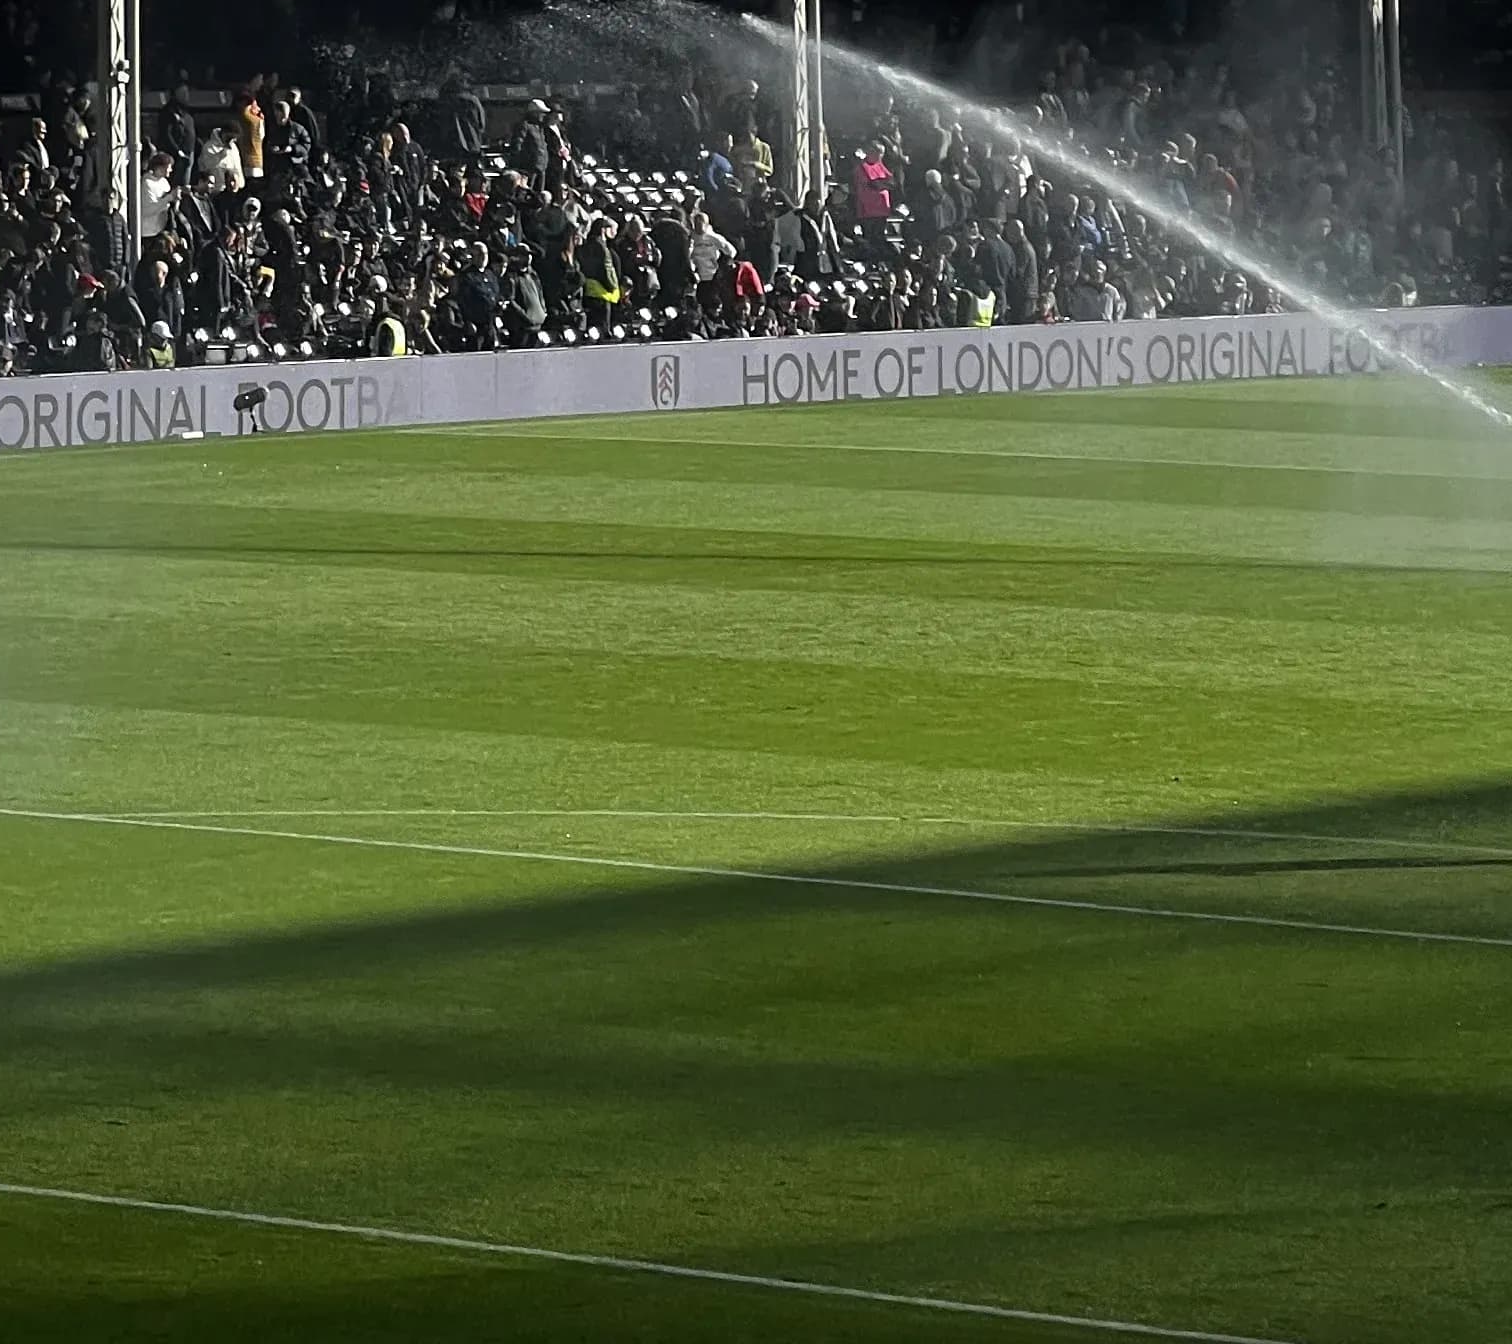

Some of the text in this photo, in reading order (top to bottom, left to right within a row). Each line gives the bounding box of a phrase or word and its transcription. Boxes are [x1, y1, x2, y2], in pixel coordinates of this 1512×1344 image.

[743, 350, 863, 404] HOME
[874, 347, 925, 398] OF
[938, 336, 1134, 396] LONDON'S
[1146, 328, 1317, 383] ORIGINAL
